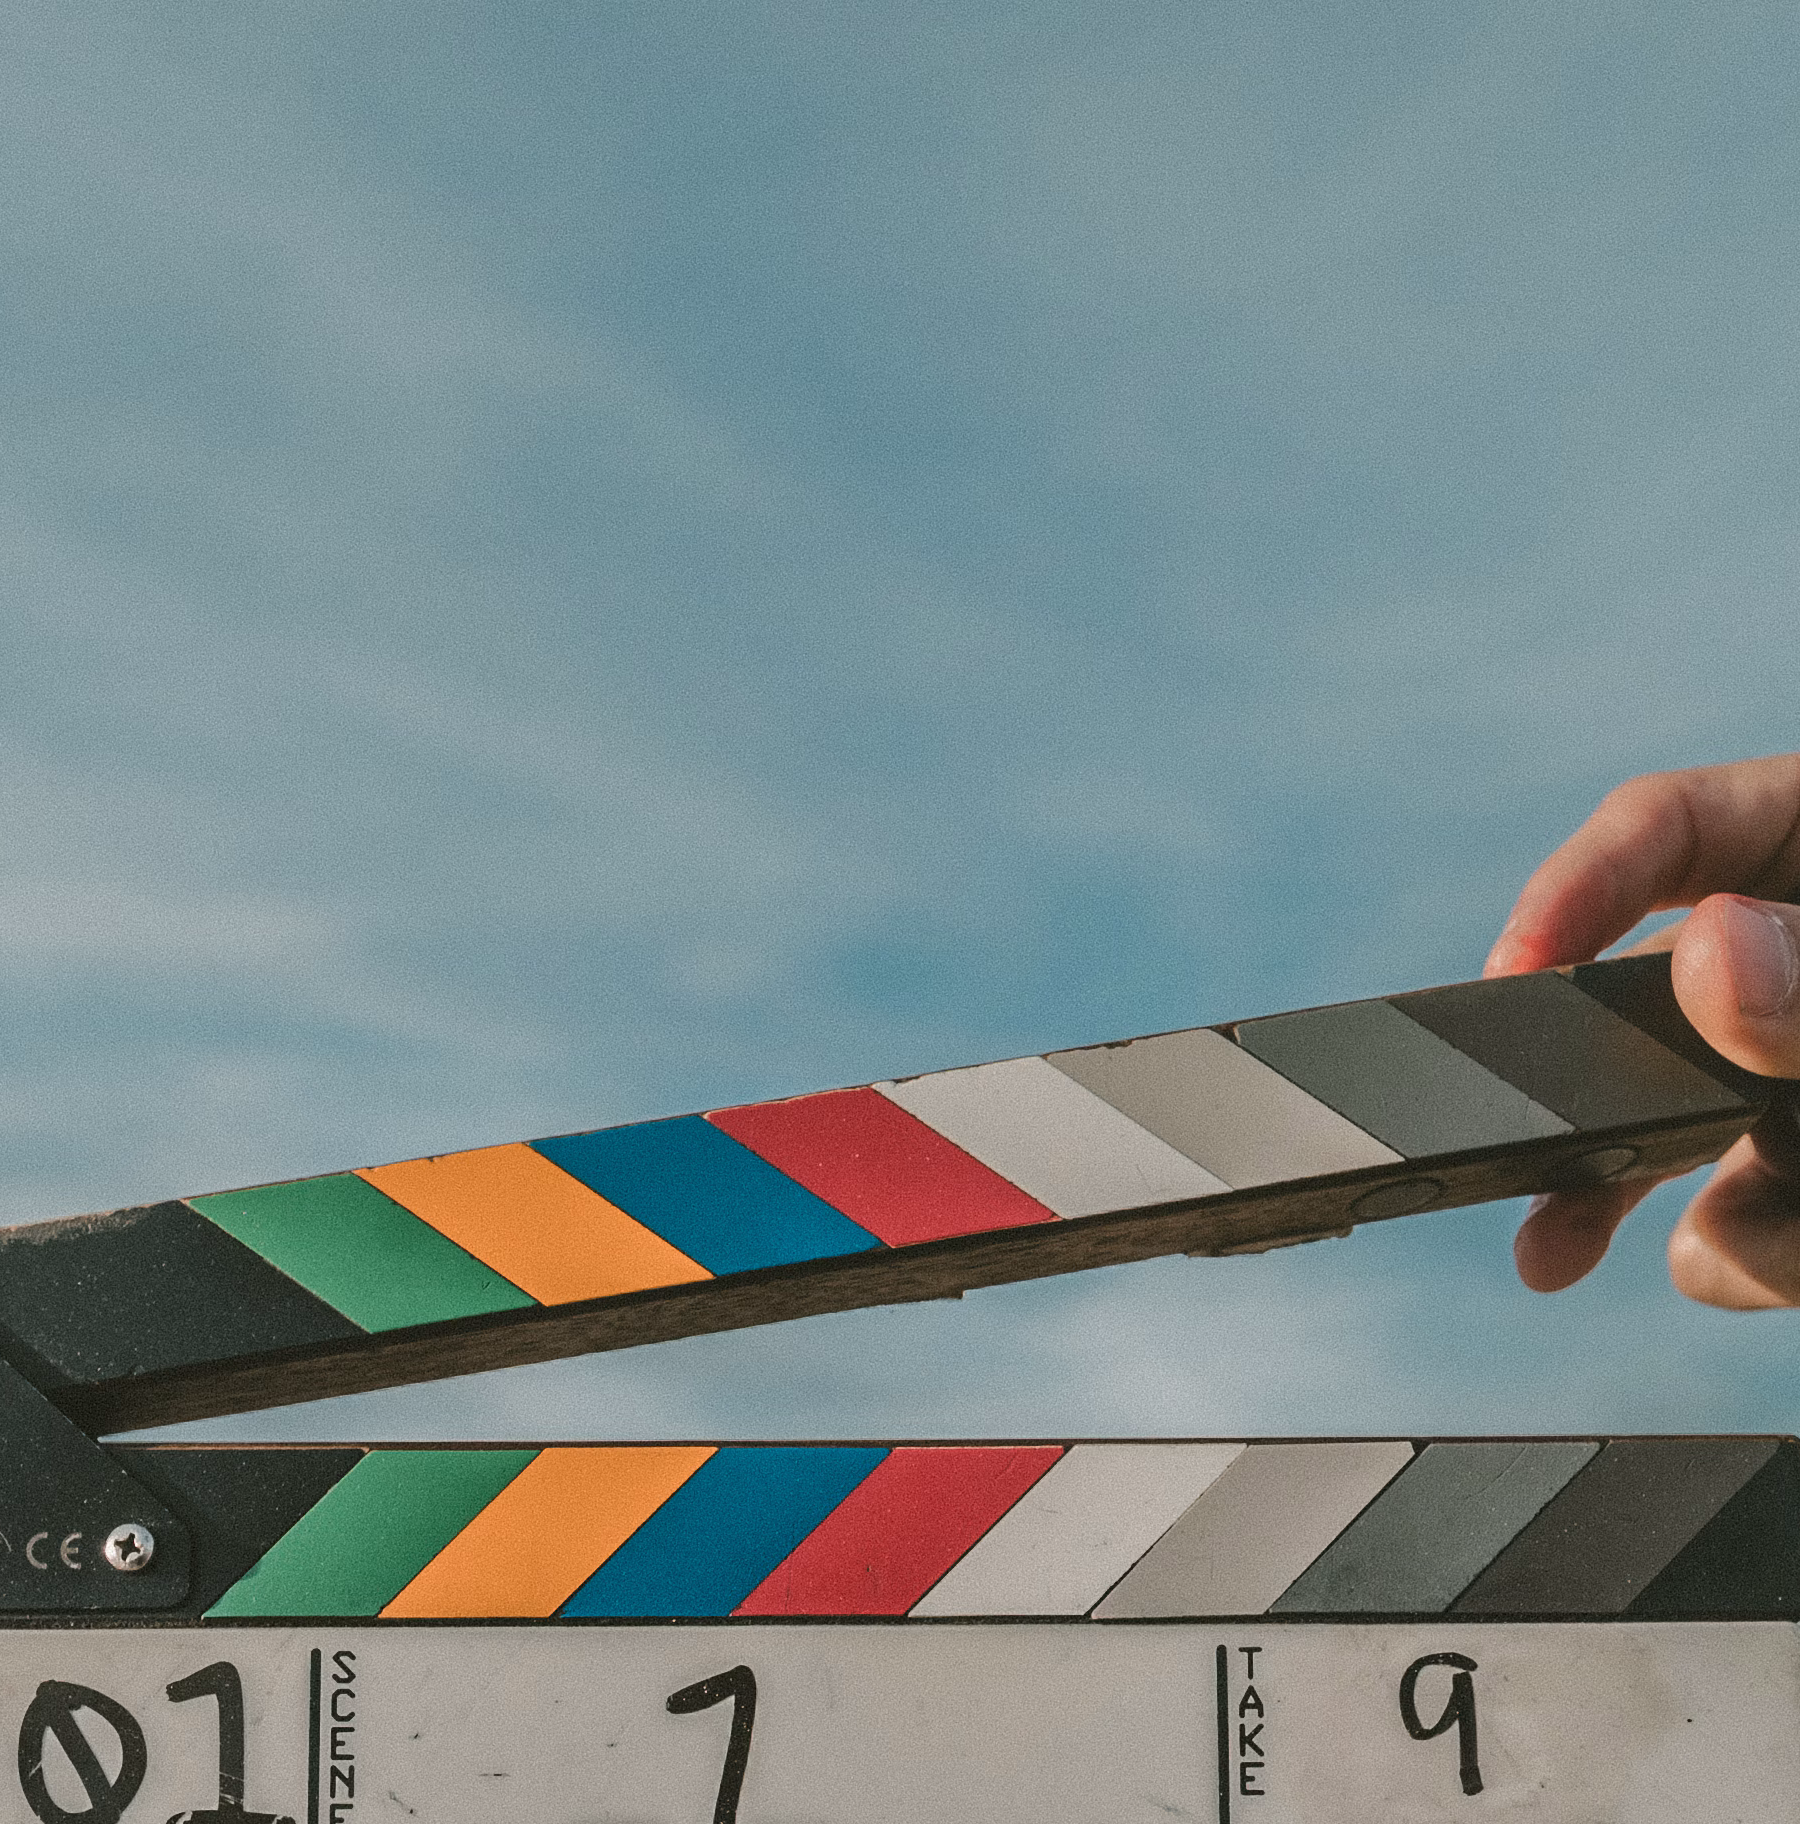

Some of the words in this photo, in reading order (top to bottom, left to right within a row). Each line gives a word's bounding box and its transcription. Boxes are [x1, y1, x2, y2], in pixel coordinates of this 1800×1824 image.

[25, 1531, 82, 1570] CE
[1238, 1646, 1266, 1797] TAKE
[1399, 1652, 1484, 1797] 9
